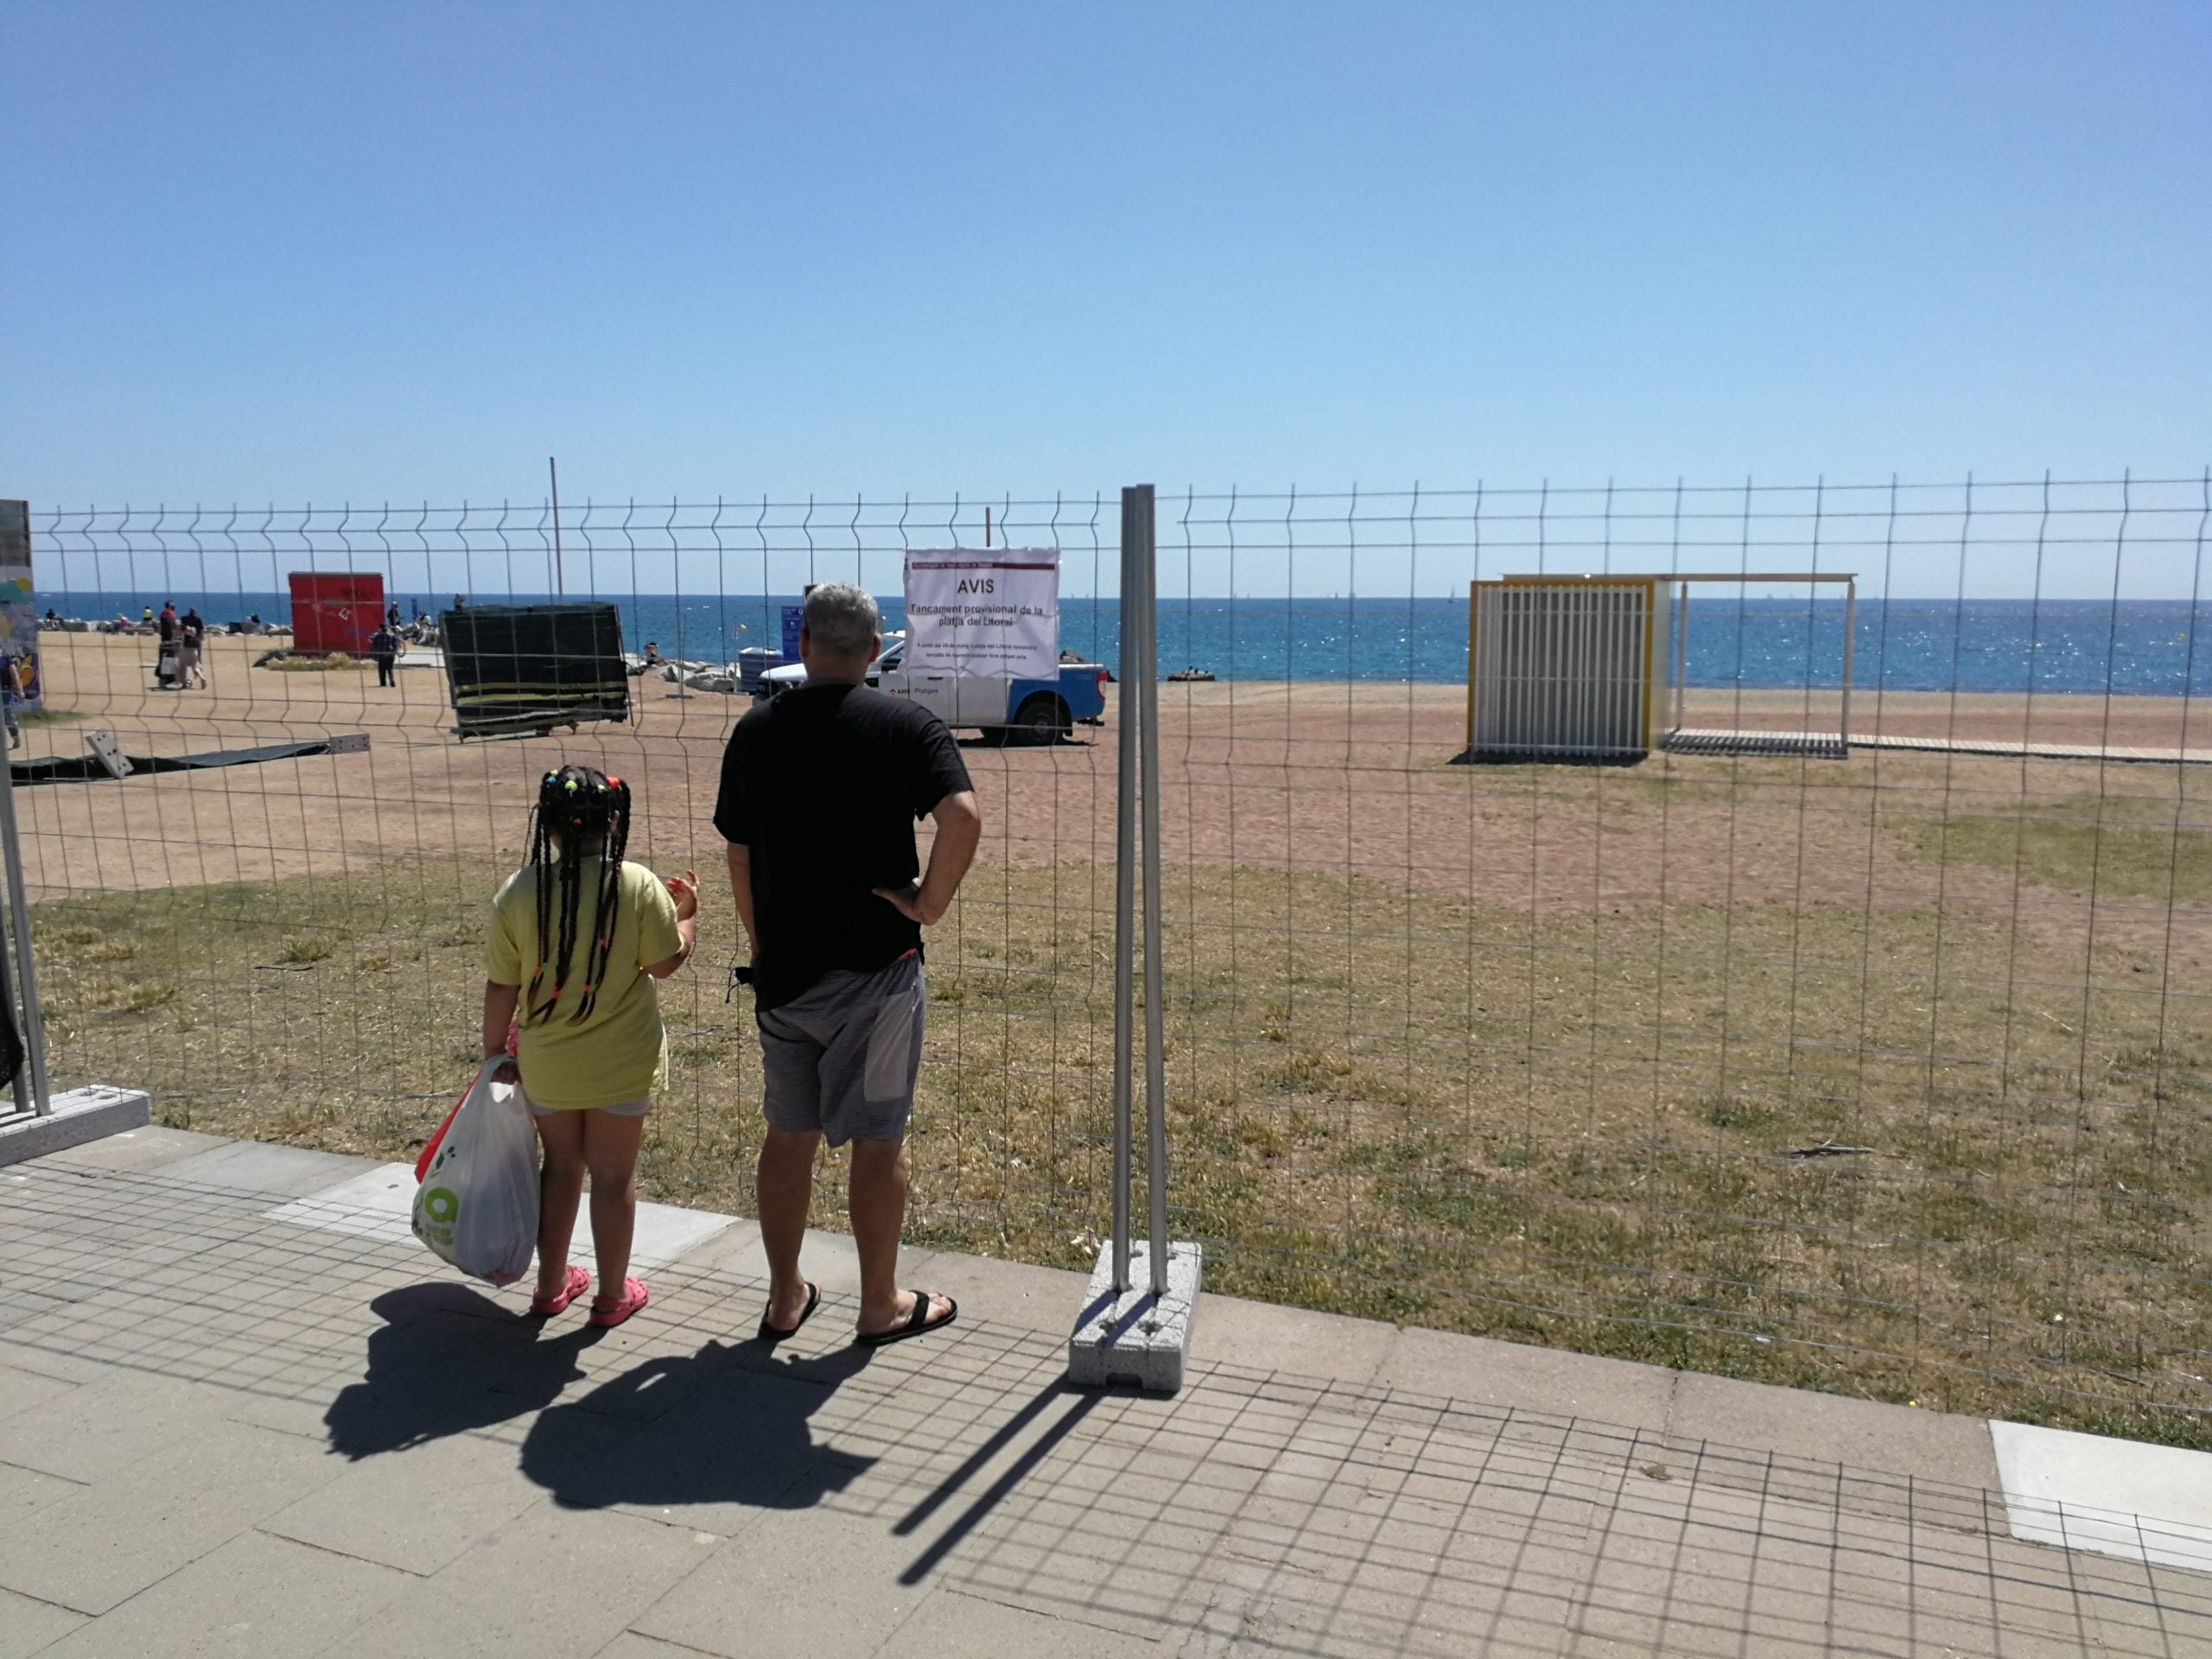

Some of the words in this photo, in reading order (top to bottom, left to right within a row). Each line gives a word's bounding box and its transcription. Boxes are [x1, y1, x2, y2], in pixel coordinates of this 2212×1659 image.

[957, 579, 995, 594] AVIS
[911, 604, 962, 613] Tancament
[964, 604, 1016, 615] provisional
[1020, 605, 1031, 614] de
[1034, 606, 1043, 614] la
[938, 616, 964, 627] platja
[967, 617, 982, 626] del
[983, 617, 1014, 626] Litoral
